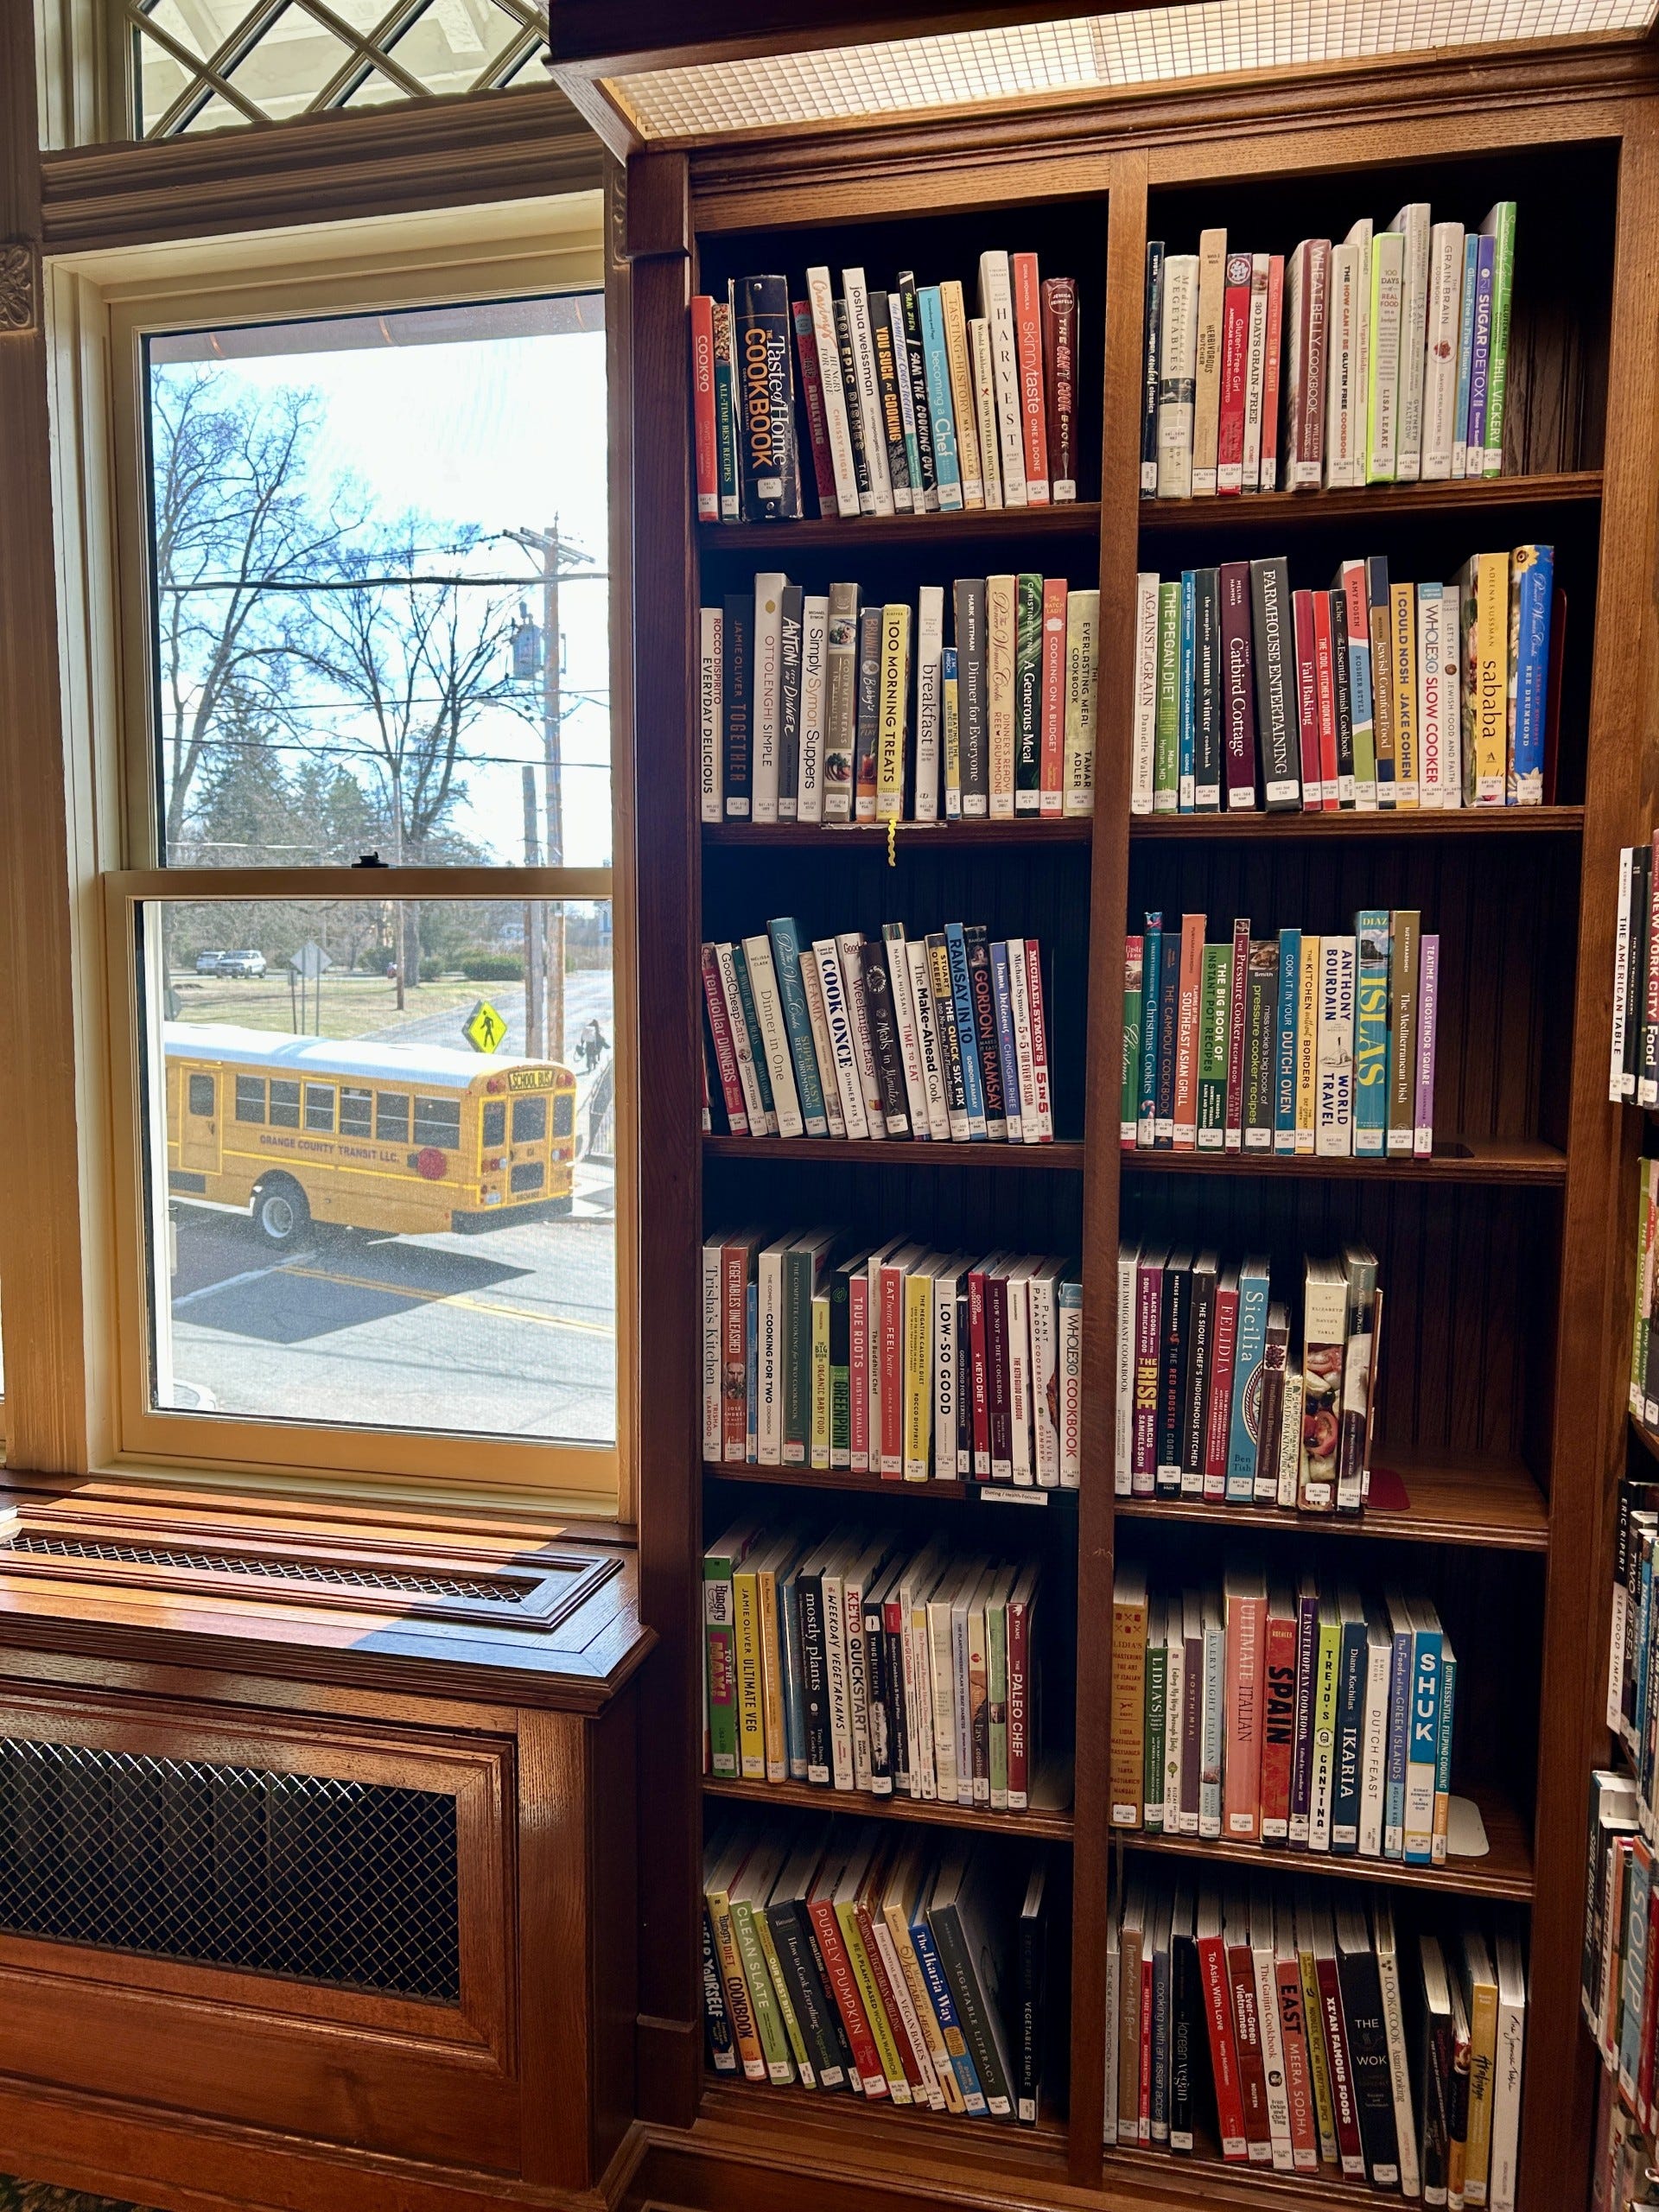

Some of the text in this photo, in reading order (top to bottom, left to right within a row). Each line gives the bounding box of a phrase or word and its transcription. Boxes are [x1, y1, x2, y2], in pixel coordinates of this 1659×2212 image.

[849, 286, 874, 396] joshua weissman
[1253, 318, 1262, 346] DAYS
[1255, 302, 1262, 315] 30
[1307, 246, 1325, 414] WHEAT BELLY COOKBOOK
[1477, 295, 1489, 345] SUGAR
[766, 336, 786, 391] Taste
[931, 350, 944, 405] becoming
[1022, 321, 1041, 414] skinnytaste
[1232, 319, 1244, 391] Gluten-Free Girl
[1474, 348, 1486, 397] DETOX
[719, 383, 728, 423] ALL-TIME
[745, 328, 773, 468] COOKBOOK
[772, 406, 789, 465] Home
[909, 353, 934, 477] SAM THE COOKING GUY
[935, 418, 951, 456] Chef
[1030, 419, 1039, 436] ONE
[1490, 359, 1504, 442] PHIL VICKERY
[722, 447, 732, 482] RECIPES
[1162, 591, 1176, 702] THE PEGAN DIET
[1398, 598, 1408, 645] COULD
[702, 658, 712, 723] EVERYDAY
[763, 635, 774, 766] OTTOLENGHI SIMPLE
[884, 620, 900, 782] 100 MORNING TREATS
[921, 664, 937, 744] breakfast
[1229, 638, 1246, 757] Catbird Cottage
[1262, 569, 1287, 774] FARMHOUSE ENTERTAINING
[1399, 648, 1409, 684] NOSH
[1427, 677, 1438, 719] SLOW
[1482, 661, 1502, 738] sababa
[804, 628, 823, 788] Simply Symon Suppers
[967, 661, 980, 781] Dinner for Everyone
[1023, 661, 1034, 763] A Generous Meal
[1400, 693, 1410, 728] JAKE
[702, 729, 712, 793] DELICIOUS
[1402, 731, 1411, 779] COHEN
[1427, 723, 1438, 783] COOKER
[821, 959, 853, 1068] COOK ONCE
[950, 938, 972, 1043] RAMSAY IN 10
[1325, 950, 1338, 1020] BOURDAIN
[1340, 950, 1352, 1020] ANTHONY
[1613, 918, 1627, 1056] THE AMERICAN TABLE
[704, 974, 736, 1083] ten dollar DINNERS
[760, 990, 785, 1080] Dinner in One
[914, 963, 941, 1103] The Make-Ahead Cook
[1178, 992, 1192, 1106] SOUTHEAST ASIAN GRILL
[1281, 955, 1294, 1113] COOK IT IN YOUR DUTCH OVEN
[1358, 976, 1387, 1086] ISLAS
[513, 1071, 550, 1088] SCHOOL BUS
[1322, 1073, 1334, 1126] TRAVEL
[1338, 1075, 1349, 1124] WORLD
[260, 1135, 296, 1147] ORANGE
[298, 1141, 334, 1154] COUNTY
[338, 1146, 377, 1159] TRANSIT
[705, 1266, 718, 1384] Trisha's Kitchen
[728, 1260, 741, 1353] VEGETABLES UNLEASHED
[854, 1296, 863, 1368] TRUE ROOTS
[1217, 1305, 1232, 1374] FELIDIA
[1241, 1292, 1263, 1361] Sicilia
[940, 1304, 950, 1414] LOW-SO GOOD
[1137, 1367, 1157, 1409] RISE
[1065, 1378, 1077, 1458] COOKBOOK
[1137, 1415, 1146, 1467] SAMUELSSON
[742, 1589, 757, 1732] JAMIE OLIVER ULTIMATE VEG
[804, 1593, 822, 1691] mostly plants
[847, 1592, 867, 1733] KETO QUICKSTART
[1237, 1605, 1255, 1742] ULTIMATE ITALIAN
[1012, 1674, 1023, 1718] PALEO
[1267, 1666, 1294, 1745] SPAIN
[1415, 1654, 1435, 1741] SHUK
[1013, 1722, 1023, 1758] CHEF
[1340, 1728, 1357, 1798] IKARIA
[736, 1907, 769, 2008] CLEAN SLATE
[815, 1908, 863, 2035] PURELY PUMPKIN
[916, 1933, 952, 2023] The Ikaria Way
[1281, 1985, 1306, 2136] EAST MEERA SODHA
[1325, 1997, 1351, 2124] XI'AN FAMOUS FOODS
[1354, 2019, 1380, 2029] THE
[1356, 2056, 1388, 2065] WOK
